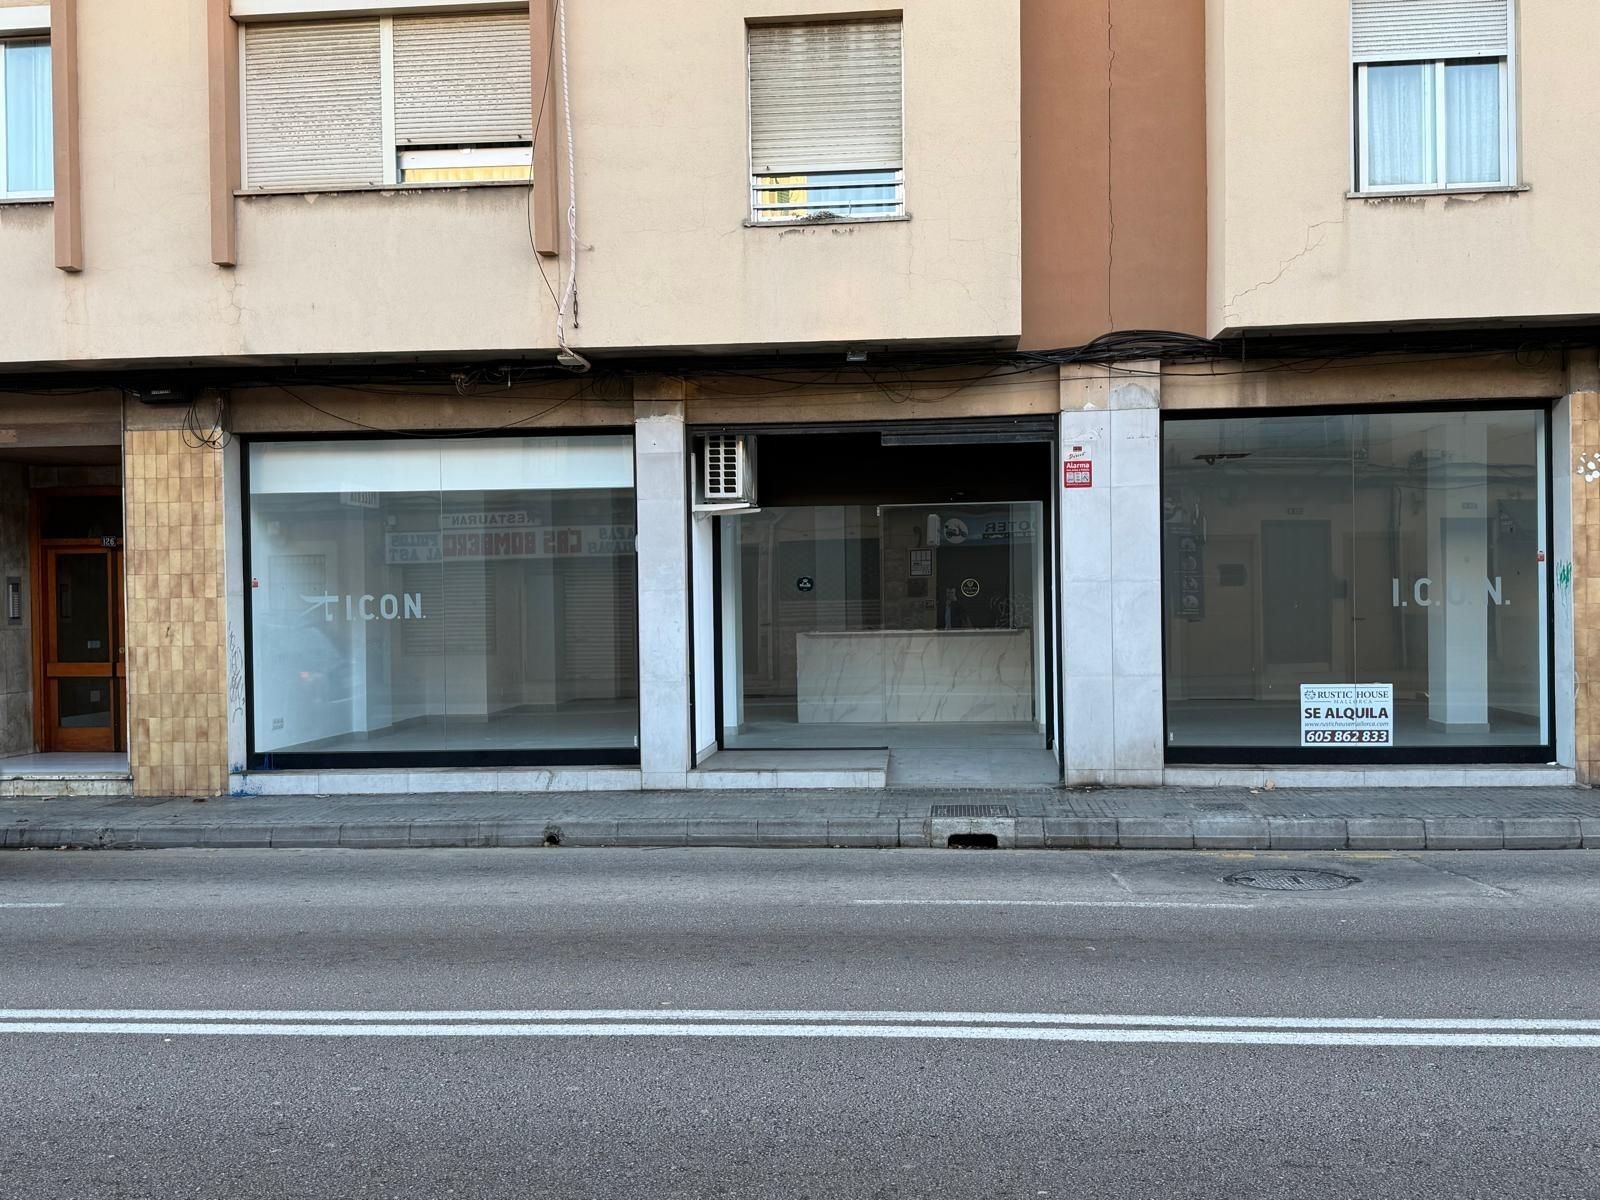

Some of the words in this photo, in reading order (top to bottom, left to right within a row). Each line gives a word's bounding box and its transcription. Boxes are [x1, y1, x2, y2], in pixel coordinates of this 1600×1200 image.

[103, 537, 115, 546] 126
[345, 593, 427, 621] I.C.O.N.
[1317, 690, 1353, 699] RUSTIC
[1356, 690, 1389, 699] HOUSE
[1304, 707, 1321, 719] SE
[1325, 707, 1388, 720] ALQUILA
[1306, 731, 1331, 742] 605
[1334, 731, 1359, 742] 862
[1362, 731, 1387, 742] 833
